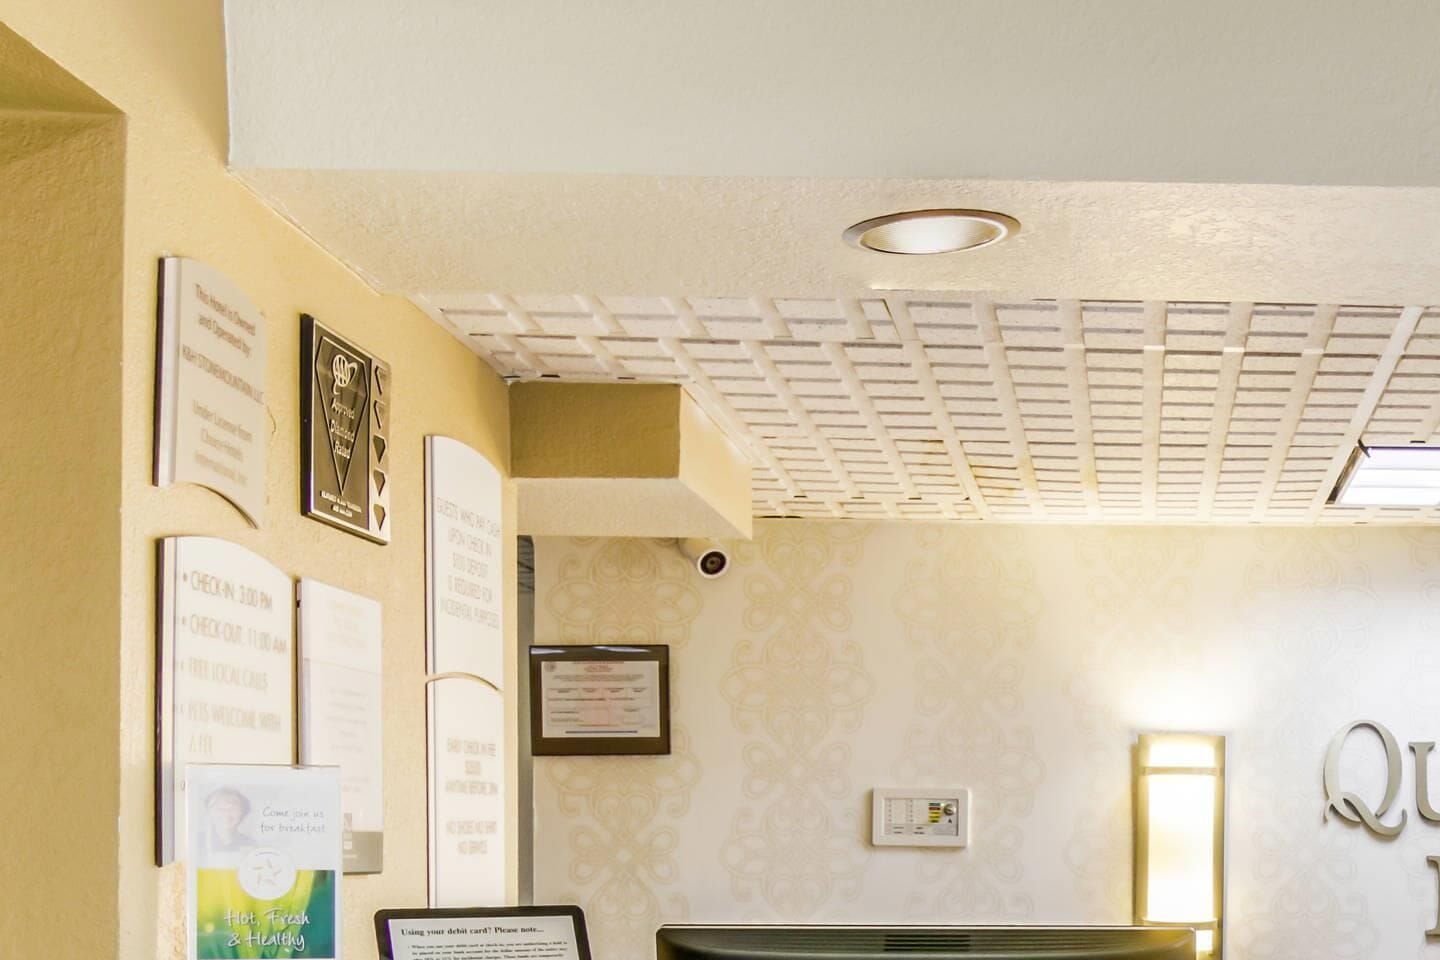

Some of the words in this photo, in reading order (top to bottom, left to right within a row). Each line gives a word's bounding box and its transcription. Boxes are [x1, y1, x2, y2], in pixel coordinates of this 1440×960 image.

[210, 295, 226, 317] Hotel
[233, 311, 256, 336] Owned
[198, 314, 212, 330] and
[212, 319, 242, 350] Operated
[331, 398, 355, 420] Approved
[330, 418, 355, 442] Diamond
[334, 440, 351, 459] Rated
[460, 507, 474, 527] WHO
[239, 585, 258, 607] 3:00
[259, 590, 273, 610] PM
[272, 635, 288, 656] AM
[188, 656, 209, 675] FREE
[211, 661, 242, 688] LOCAL
[210, 703, 256, 730] WELCOME
[262, 805, 288, 818] Come
[292, 809, 309, 822] join
[260, 822, 276, 835] for
[278, 823, 326, 835] breakfast
[224, 907, 261, 927] Hot,
[264, 907, 310, 926] Fresh
[228, 933, 241, 947] &
[244, 930, 305, 952] Healthy
[401, 928, 425, 936] Using
[427, 929, 444, 937] your
[448, 926, 467, 935] debit
[470, 926, 492, 935] card?
[494, 926, 518, 934] Please
